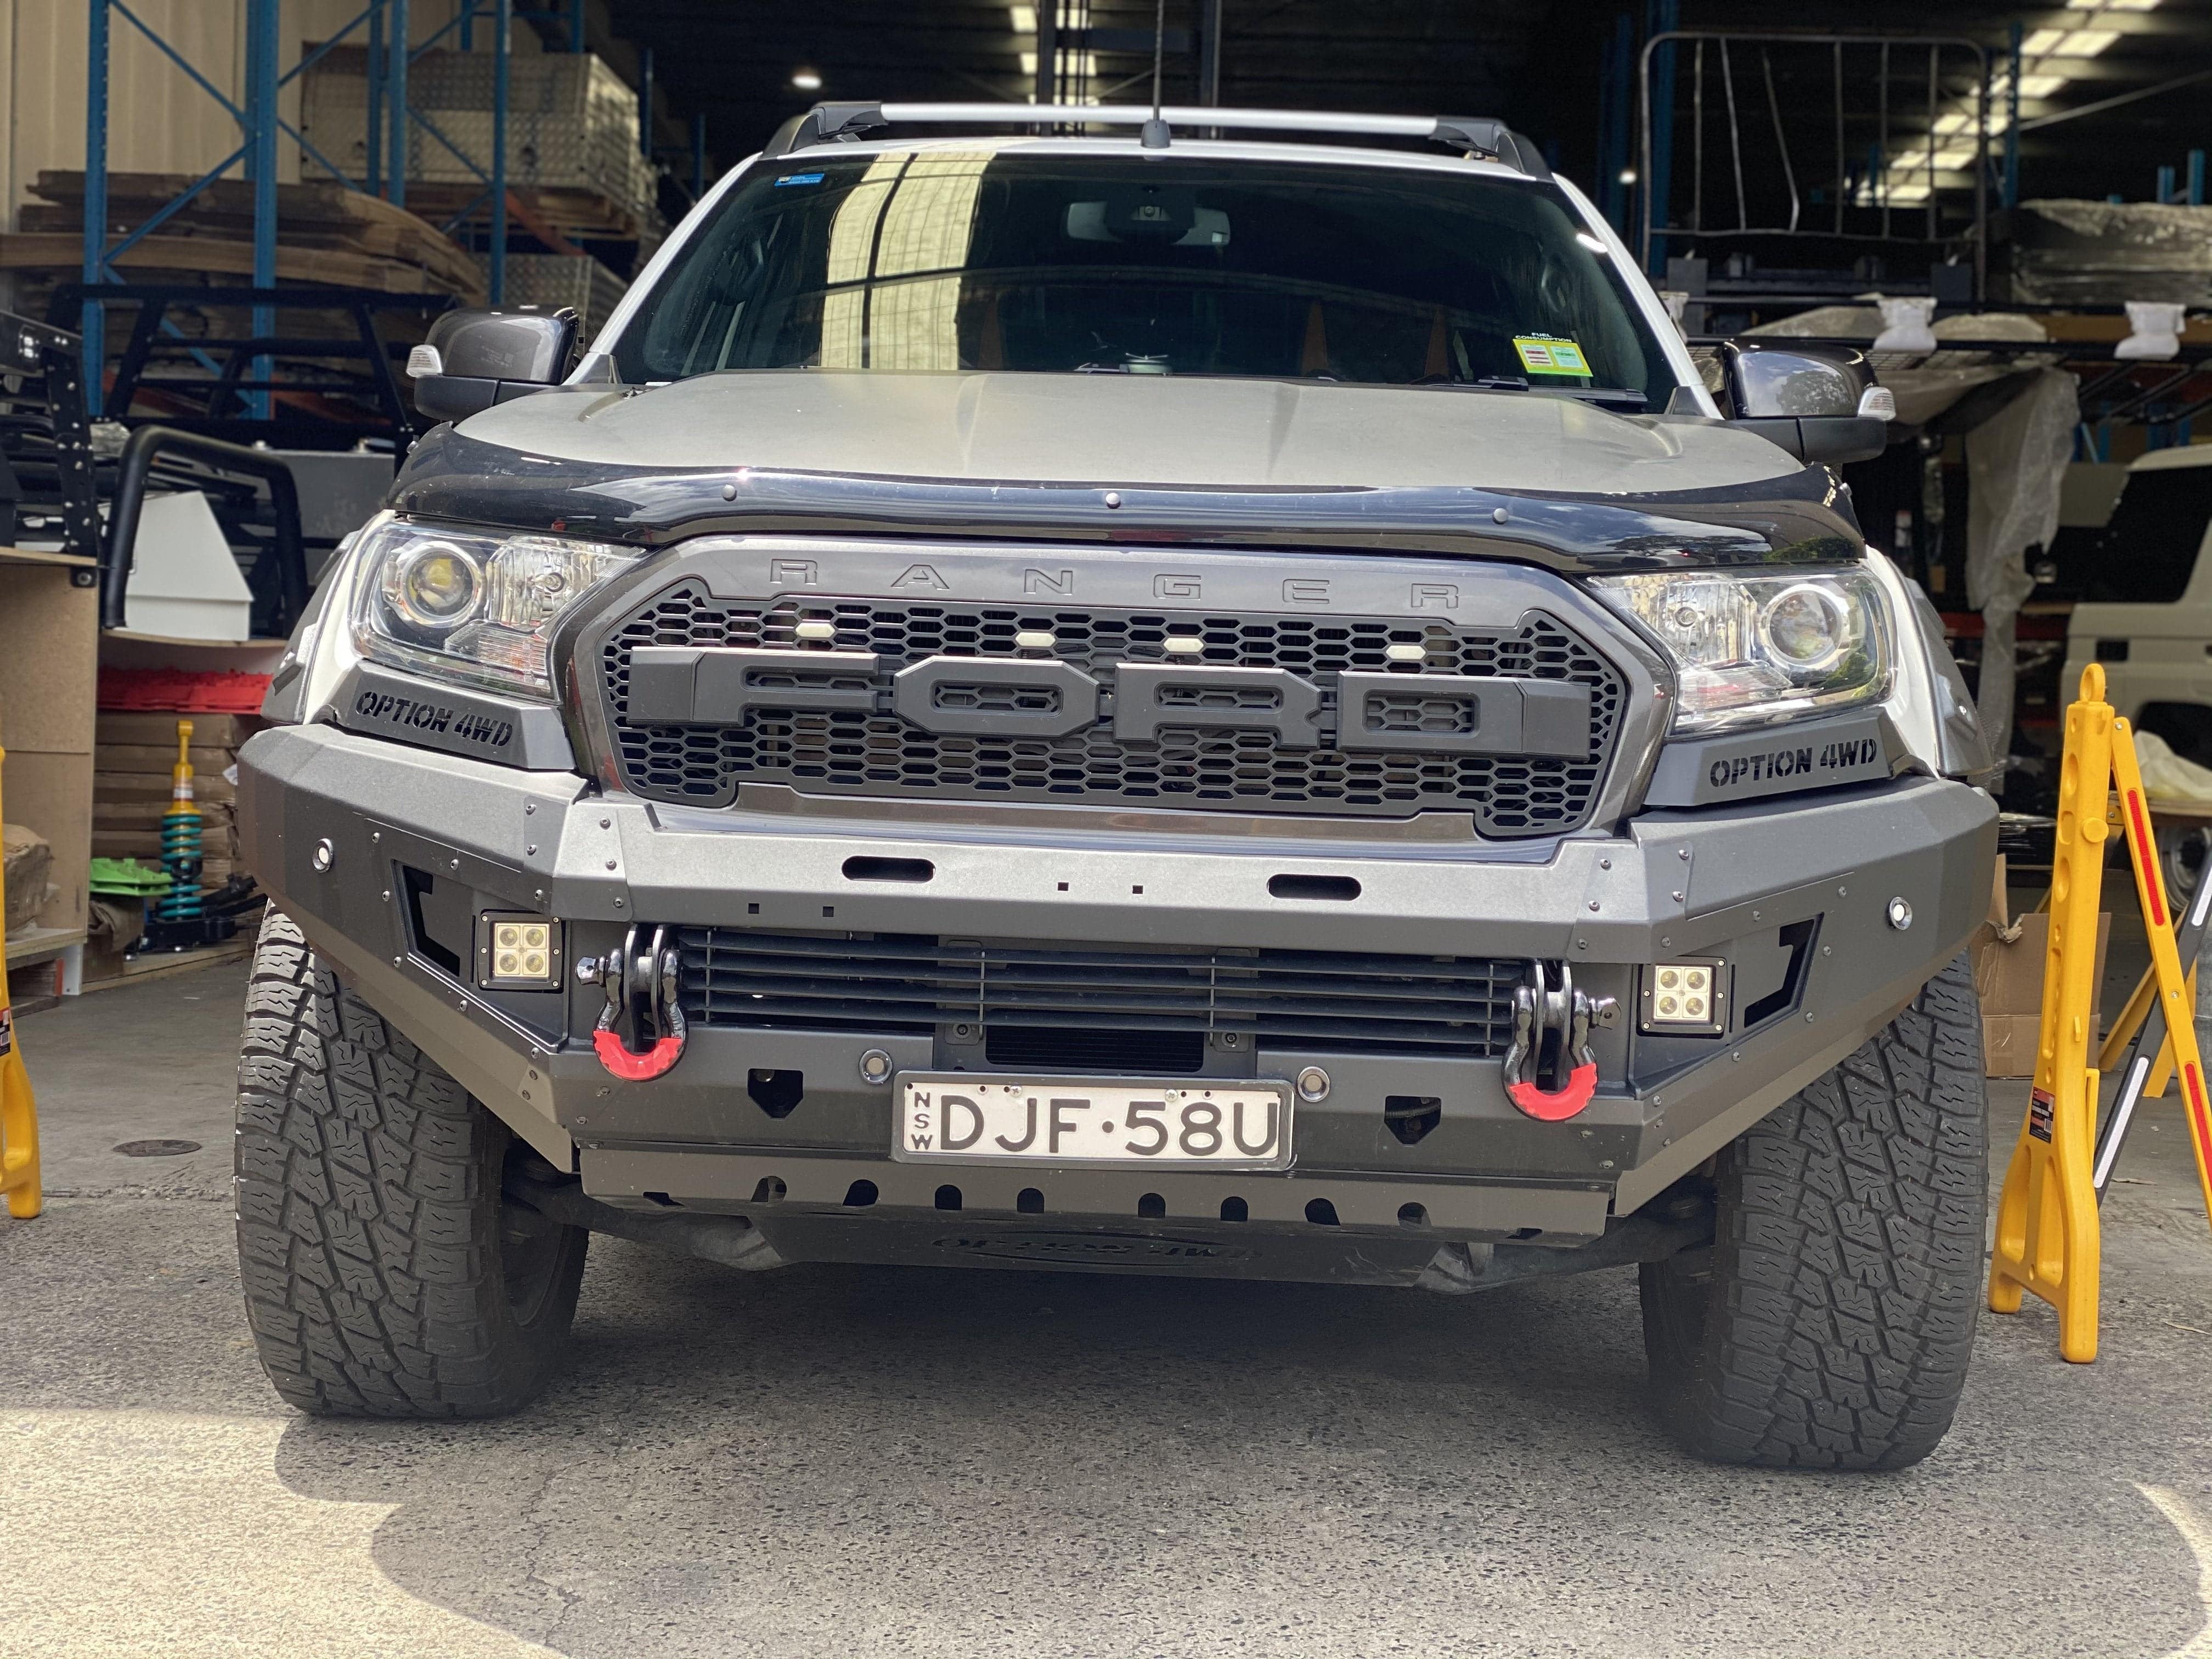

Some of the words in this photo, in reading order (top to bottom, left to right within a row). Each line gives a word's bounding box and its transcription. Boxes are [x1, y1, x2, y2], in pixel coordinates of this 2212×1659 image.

[769, 558, 1460, 610] RANGER
[356, 691, 454, 733] OPTION
[454, 714, 514, 747] 4WD
[627, 646, 1591, 762] FORD
[1709, 747, 1813, 787] OPTION
[1819, 738, 1878, 769] 4WD
[911, 1092, 933, 1150] NSW
